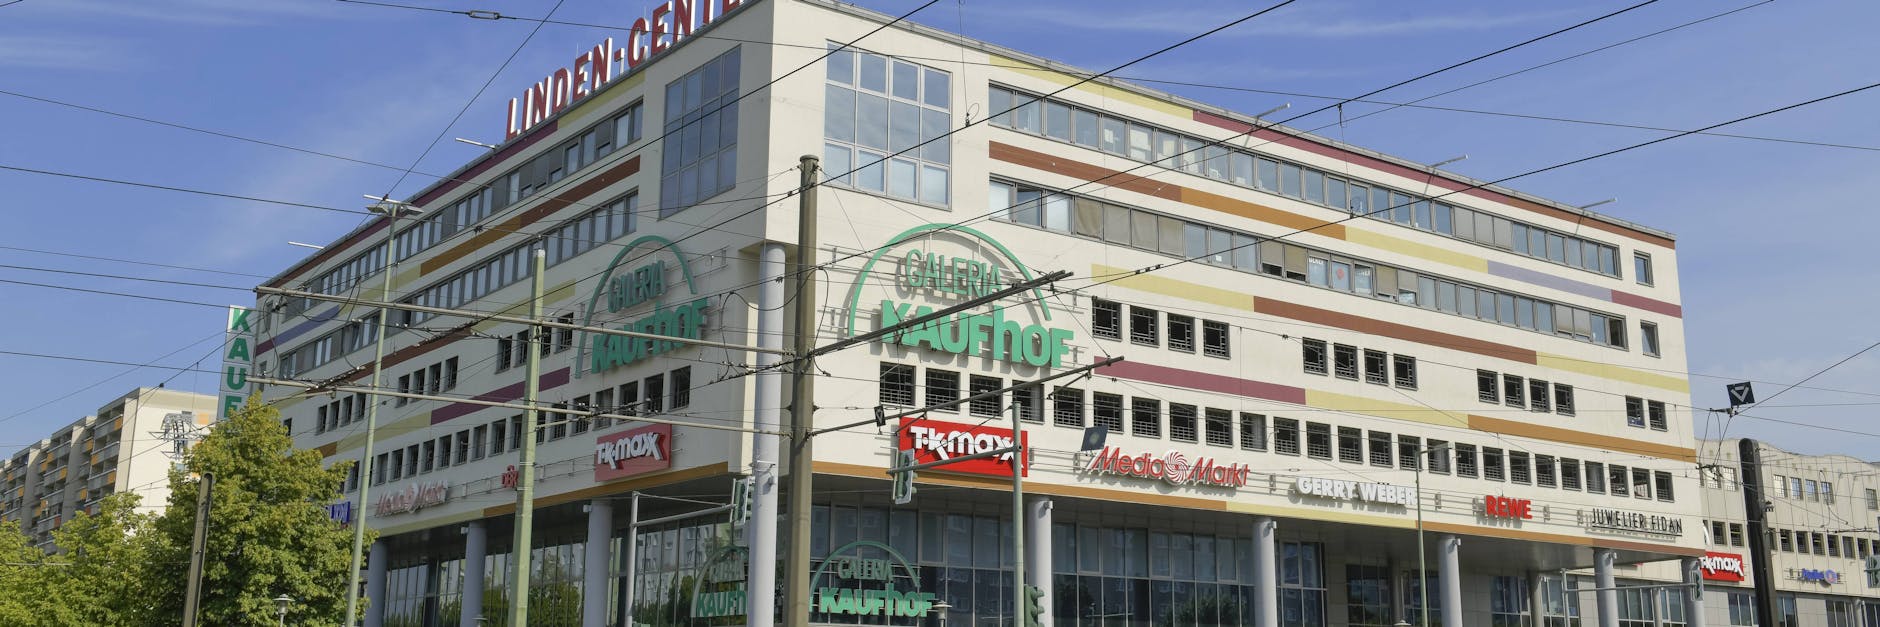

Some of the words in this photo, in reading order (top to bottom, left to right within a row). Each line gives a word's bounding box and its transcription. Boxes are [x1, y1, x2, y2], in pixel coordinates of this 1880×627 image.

[506, 0, 744, 141] LINDEN-CEN
[608, 260, 665, 313] GALERIA
[905, 249, 1002, 297] GALERIA
[1090, 445, 1165, 478] Media
[1187, 457, 1248, 487] Markt
[1297, 477, 1356, 500] GERRY
[1360, 482, 1417, 506] WEBER
[1485, 495, 1533, 520] REWE
[1592, 507, 1645, 529] JUWELIER
[1651, 514, 1683, 534] FIDAN
[838, 557, 894, 582] GALERIA
